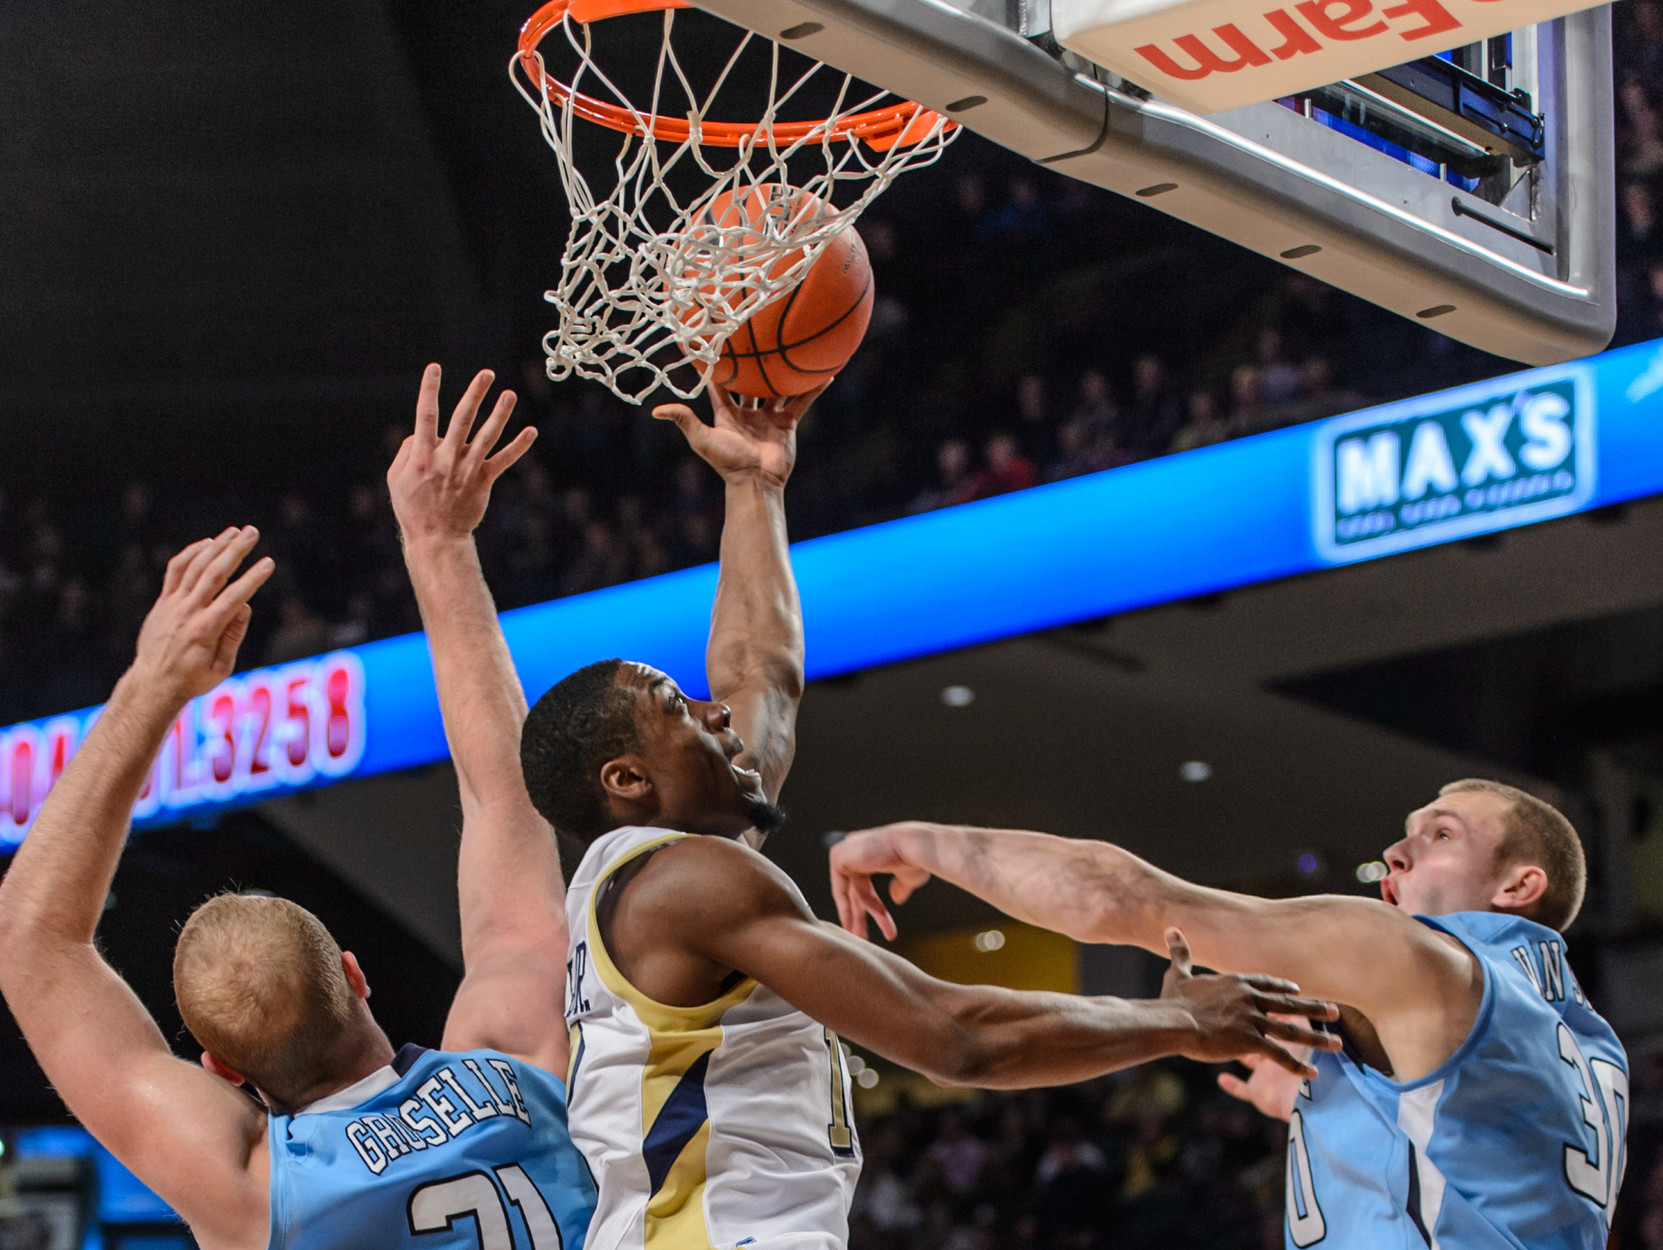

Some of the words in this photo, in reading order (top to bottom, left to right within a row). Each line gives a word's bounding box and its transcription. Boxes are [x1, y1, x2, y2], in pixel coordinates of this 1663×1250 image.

[1133, 0, 1463, 80] Farm
[1336, 391, 1574, 516] MAX'S
[1556, 1022, 1630, 1234] 30
